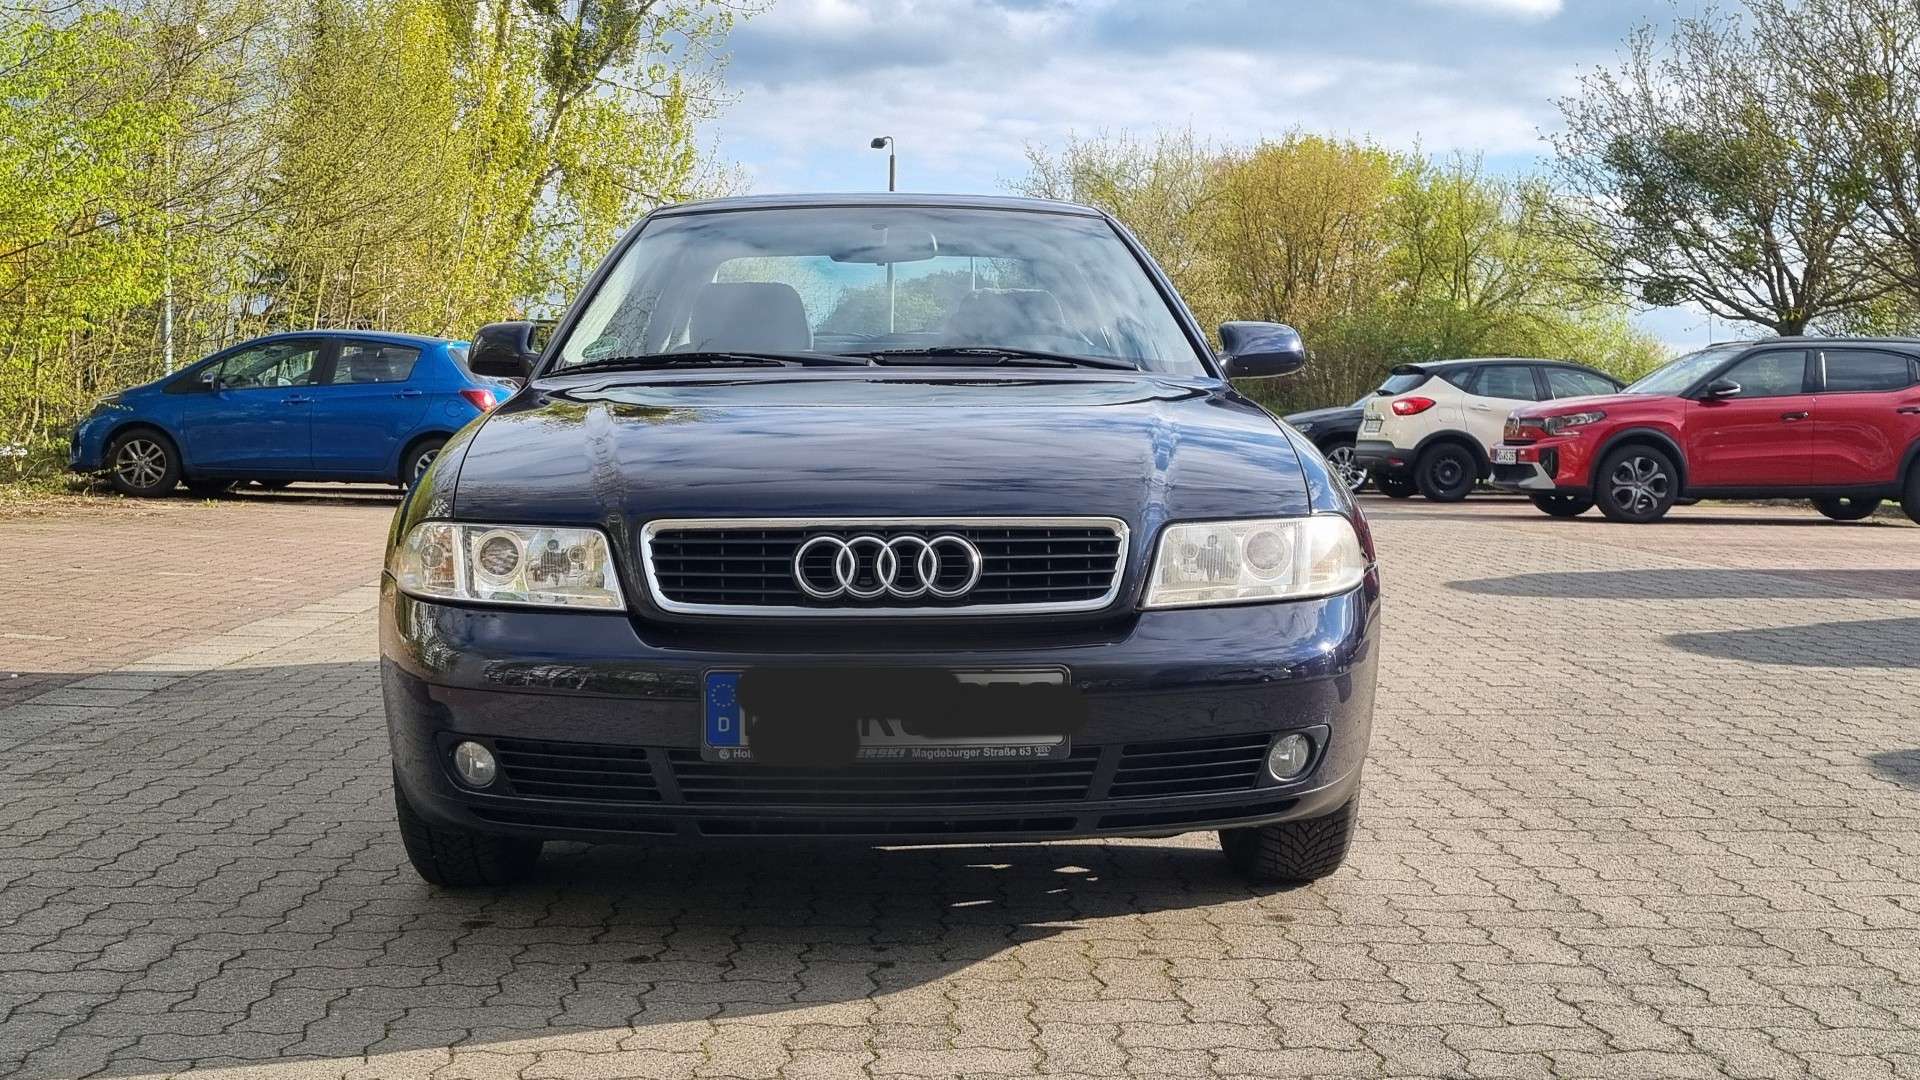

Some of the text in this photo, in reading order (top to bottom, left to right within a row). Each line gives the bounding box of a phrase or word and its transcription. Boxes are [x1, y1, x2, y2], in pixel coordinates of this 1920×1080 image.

[718, 717, 730, 732] D
[733, 749, 754, 759] Hol
[911, 747, 980, 760] Magdeburger
[983, 746, 1017, 757] Straße
[1019, 746, 1032, 756] 63
